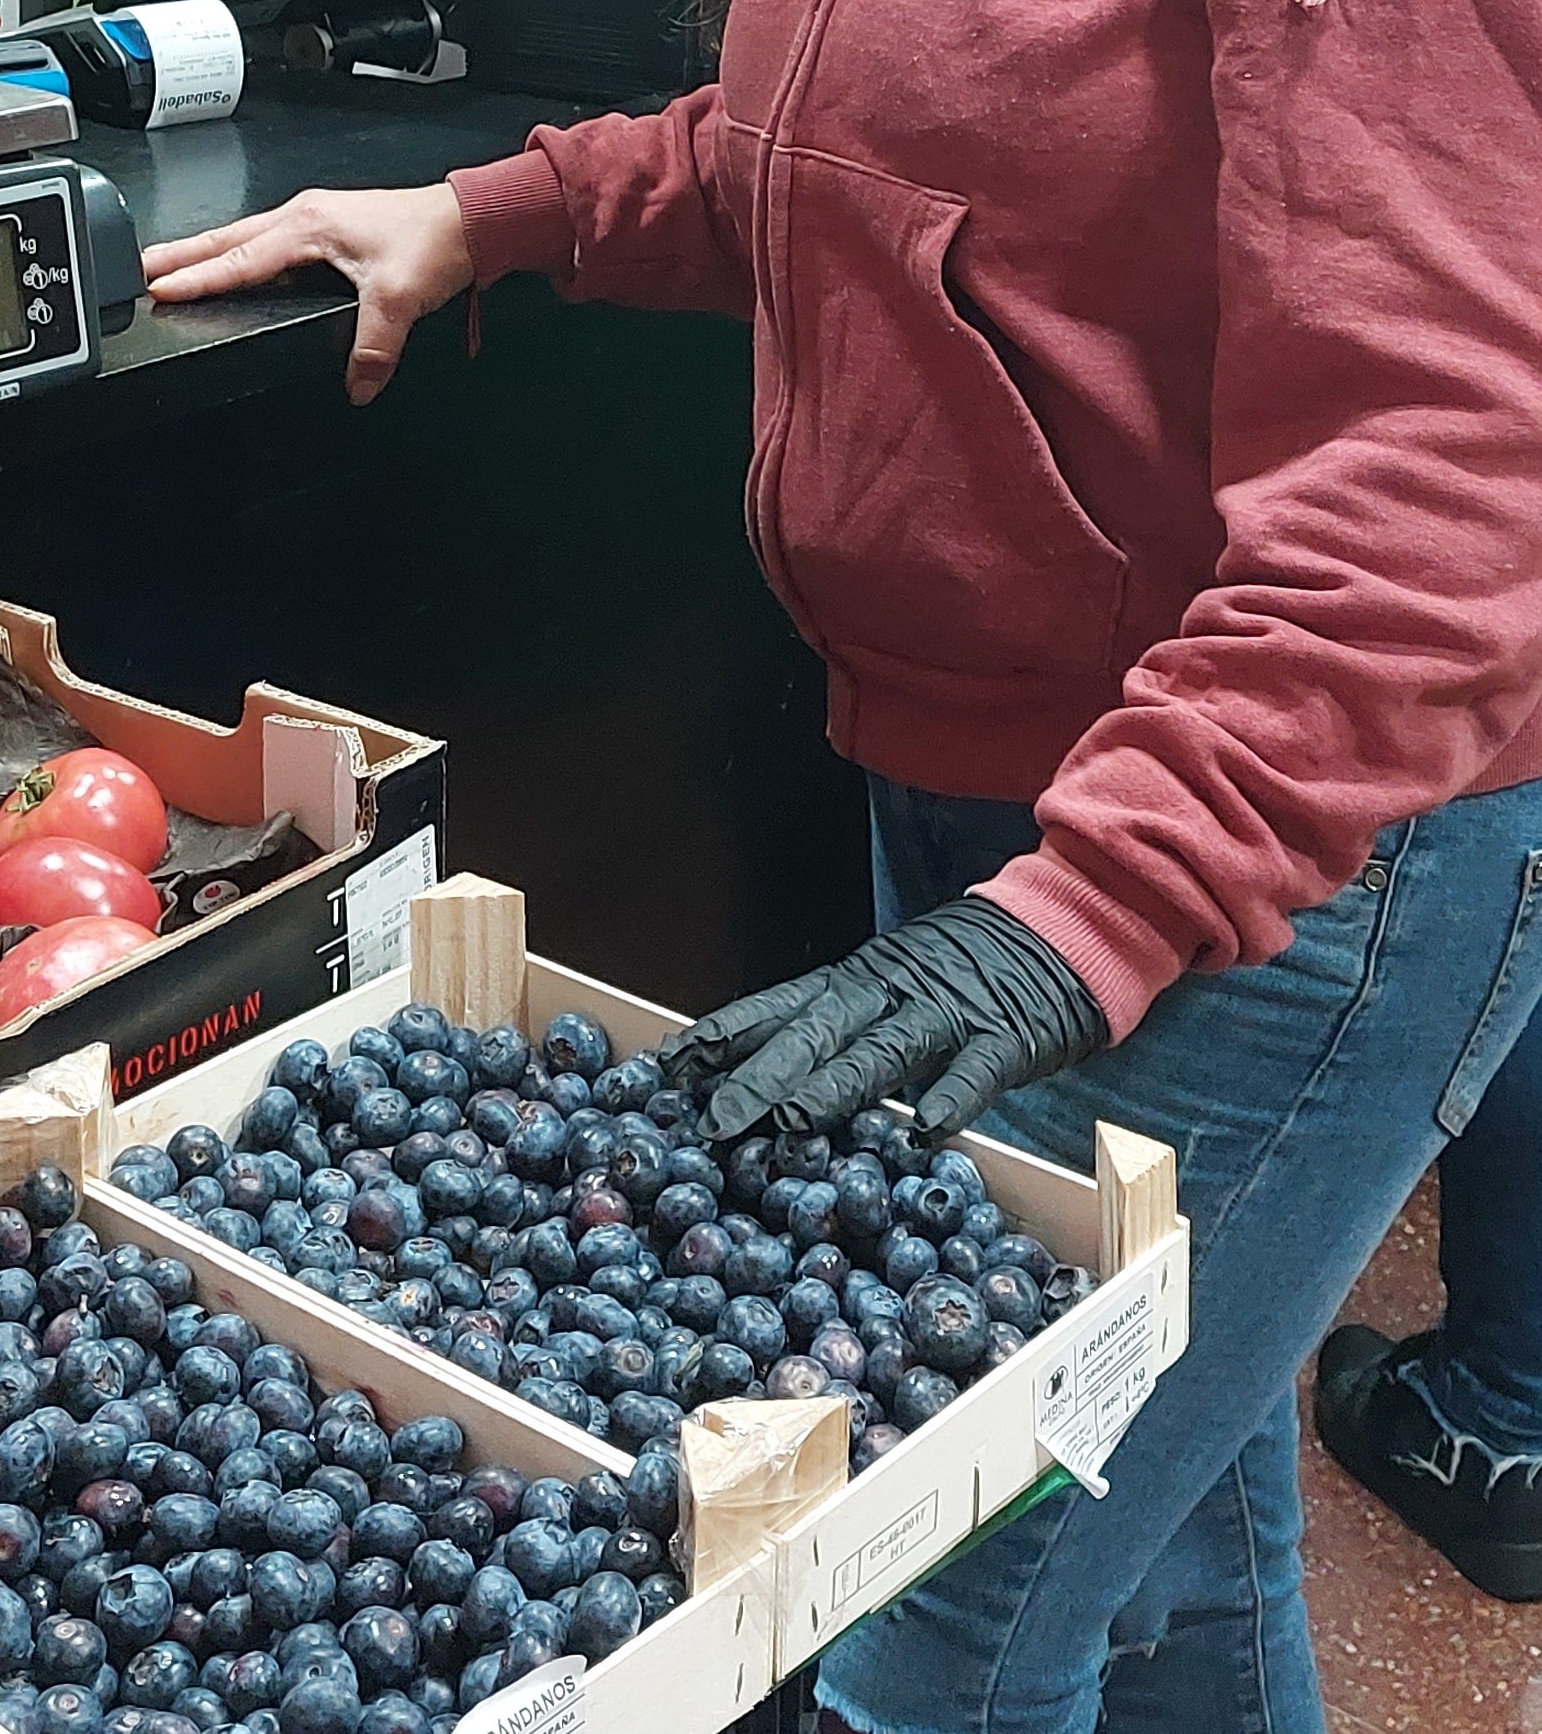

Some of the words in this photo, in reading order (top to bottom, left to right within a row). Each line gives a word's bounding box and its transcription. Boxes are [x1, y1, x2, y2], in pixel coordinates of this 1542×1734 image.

[159, 90, 222, 112] Sabadell
[19, 236, 37, 254] kg
[1081, 1294, 1148, 1365] ARÁNDANOS
[1039, 1392, 1074, 1428] MEDINA
